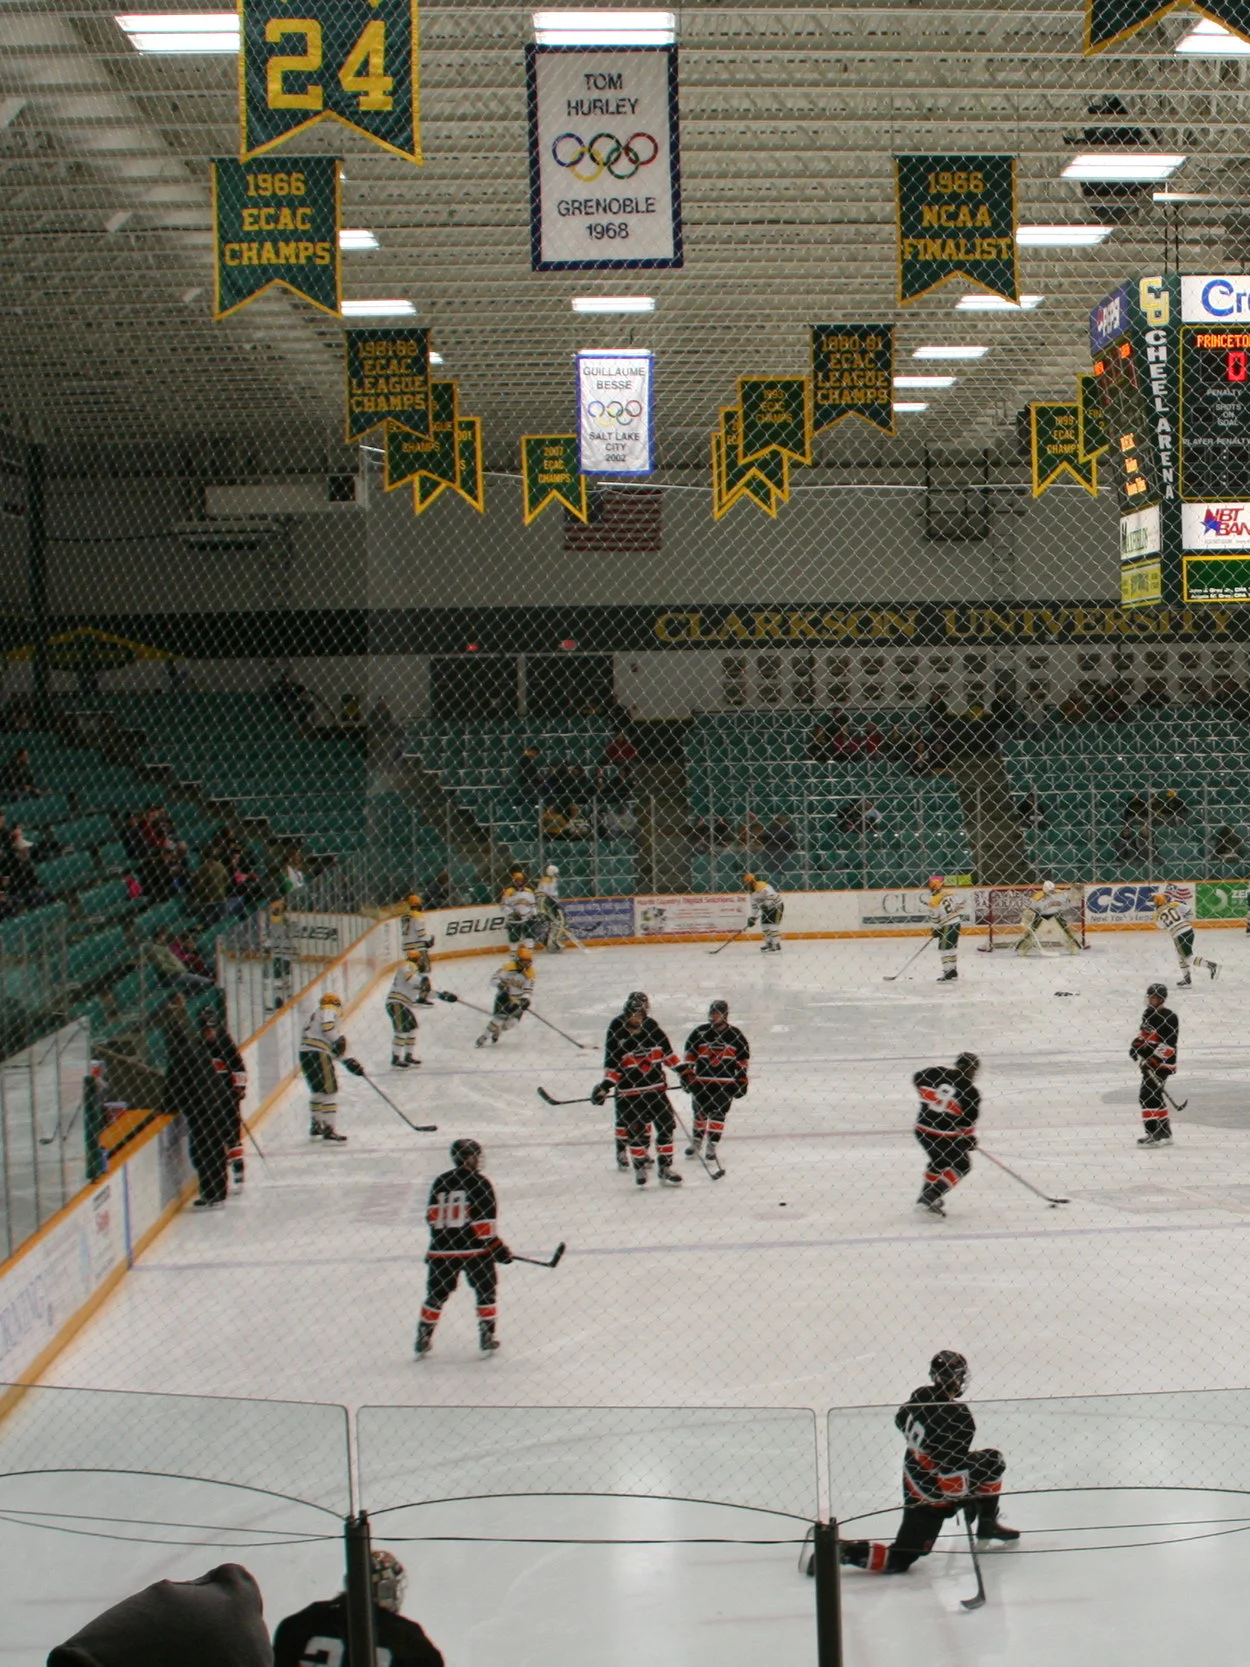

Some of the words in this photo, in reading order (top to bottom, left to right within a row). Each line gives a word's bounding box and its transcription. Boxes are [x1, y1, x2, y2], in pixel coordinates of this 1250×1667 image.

[265, 18, 393, 110] 24
[584, 72, 623, 90] TOM
[567, 97, 639, 116] HURLEY
[245, 172, 306, 197] 1966
[557, 197, 656, 217] GRENOBLE
[921, 204, 992, 228] NCAA
[242, 206, 313, 231] ECAC
[585, 222, 630, 240] 1968
[223, 241, 332, 266] CHAMPS
[903, 237, 1012, 261] FINALIST
[583, 366, 646, 377] GUILLAUME
[1227, 351, 1248, 382] 0
[350, 376, 427, 393] LEAGUE
[817, 371, 889, 388] LEAGUE
[351, 394, 426, 411] CHAMPS
[818, 389, 889, 405] CHAMPS
[589, 431, 612, 441] SALT
[615, 431, 641, 440] LAKE
[605, 442, 627, 452] CITY
[1204, 507, 1245, 522] NBT
[655, 610, 920, 641] CLARKSON
[940, 606, 1236, 638] UNIVERSITY
